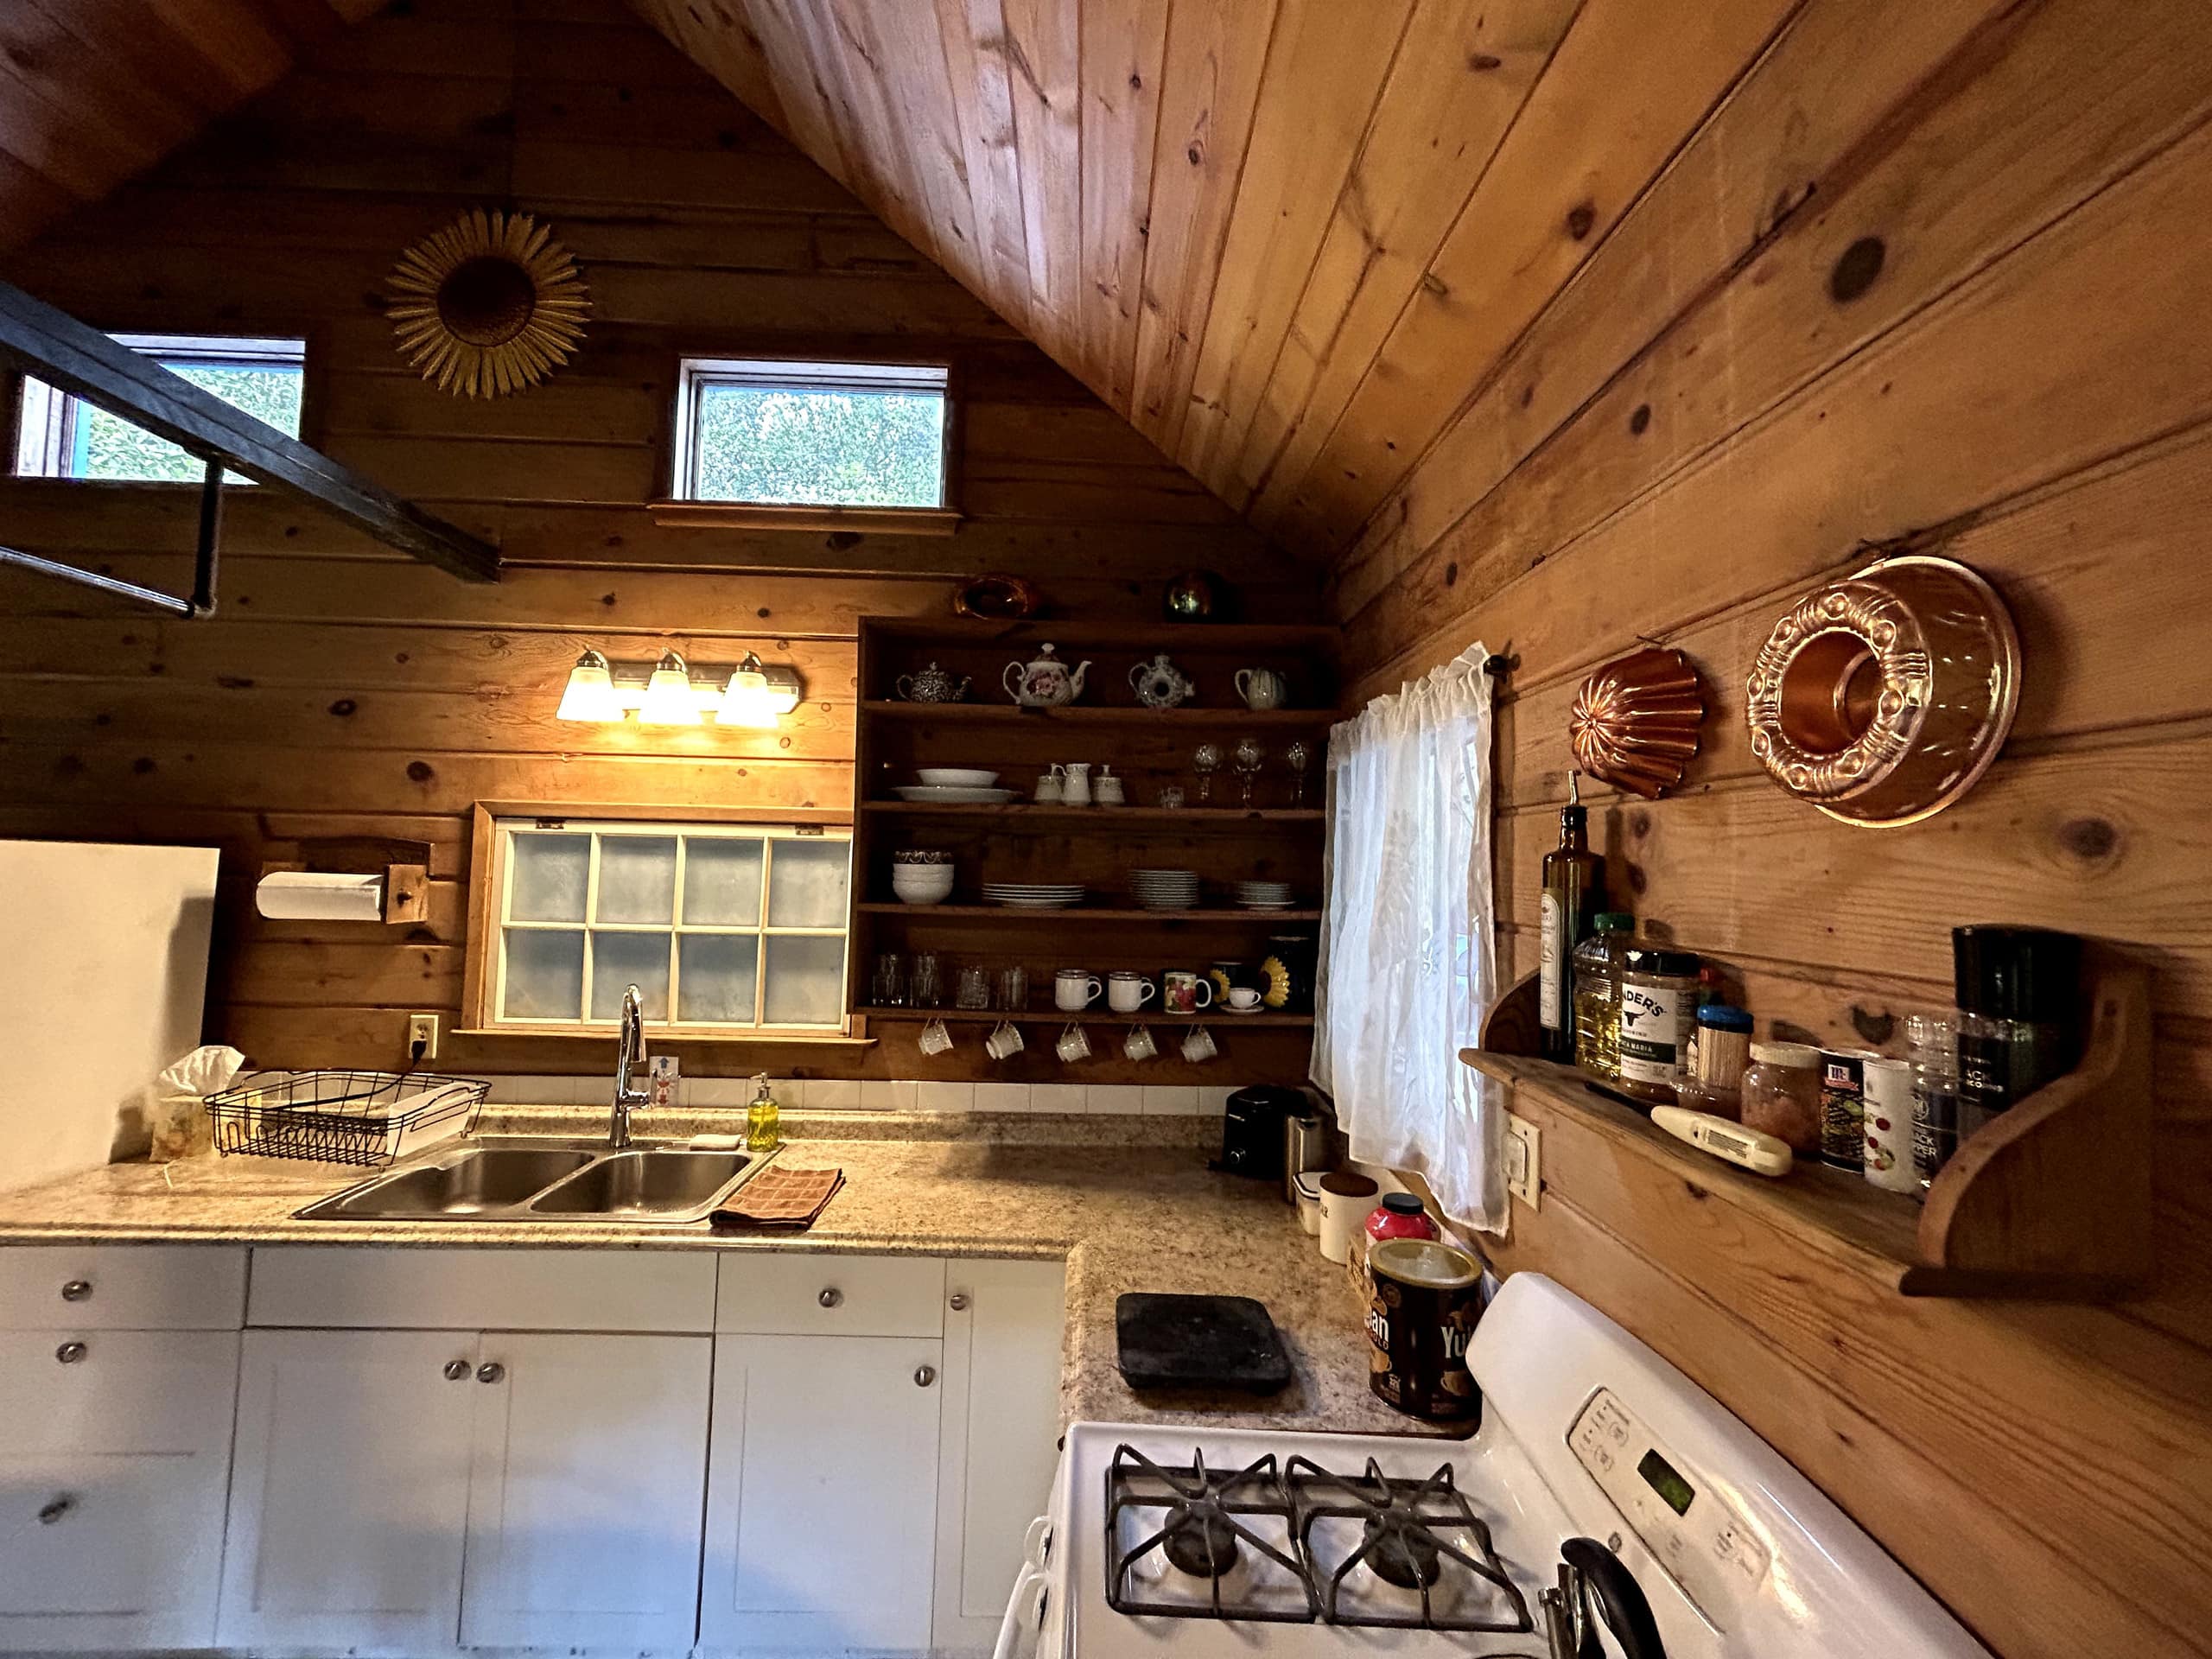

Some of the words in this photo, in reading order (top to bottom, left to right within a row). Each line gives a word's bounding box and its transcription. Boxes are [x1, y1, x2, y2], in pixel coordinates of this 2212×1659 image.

[1624, 990, 1664, 1017] DER'S
[1371, 1309, 1389, 1343] an
[1440, 1325, 1470, 1359] Yu
